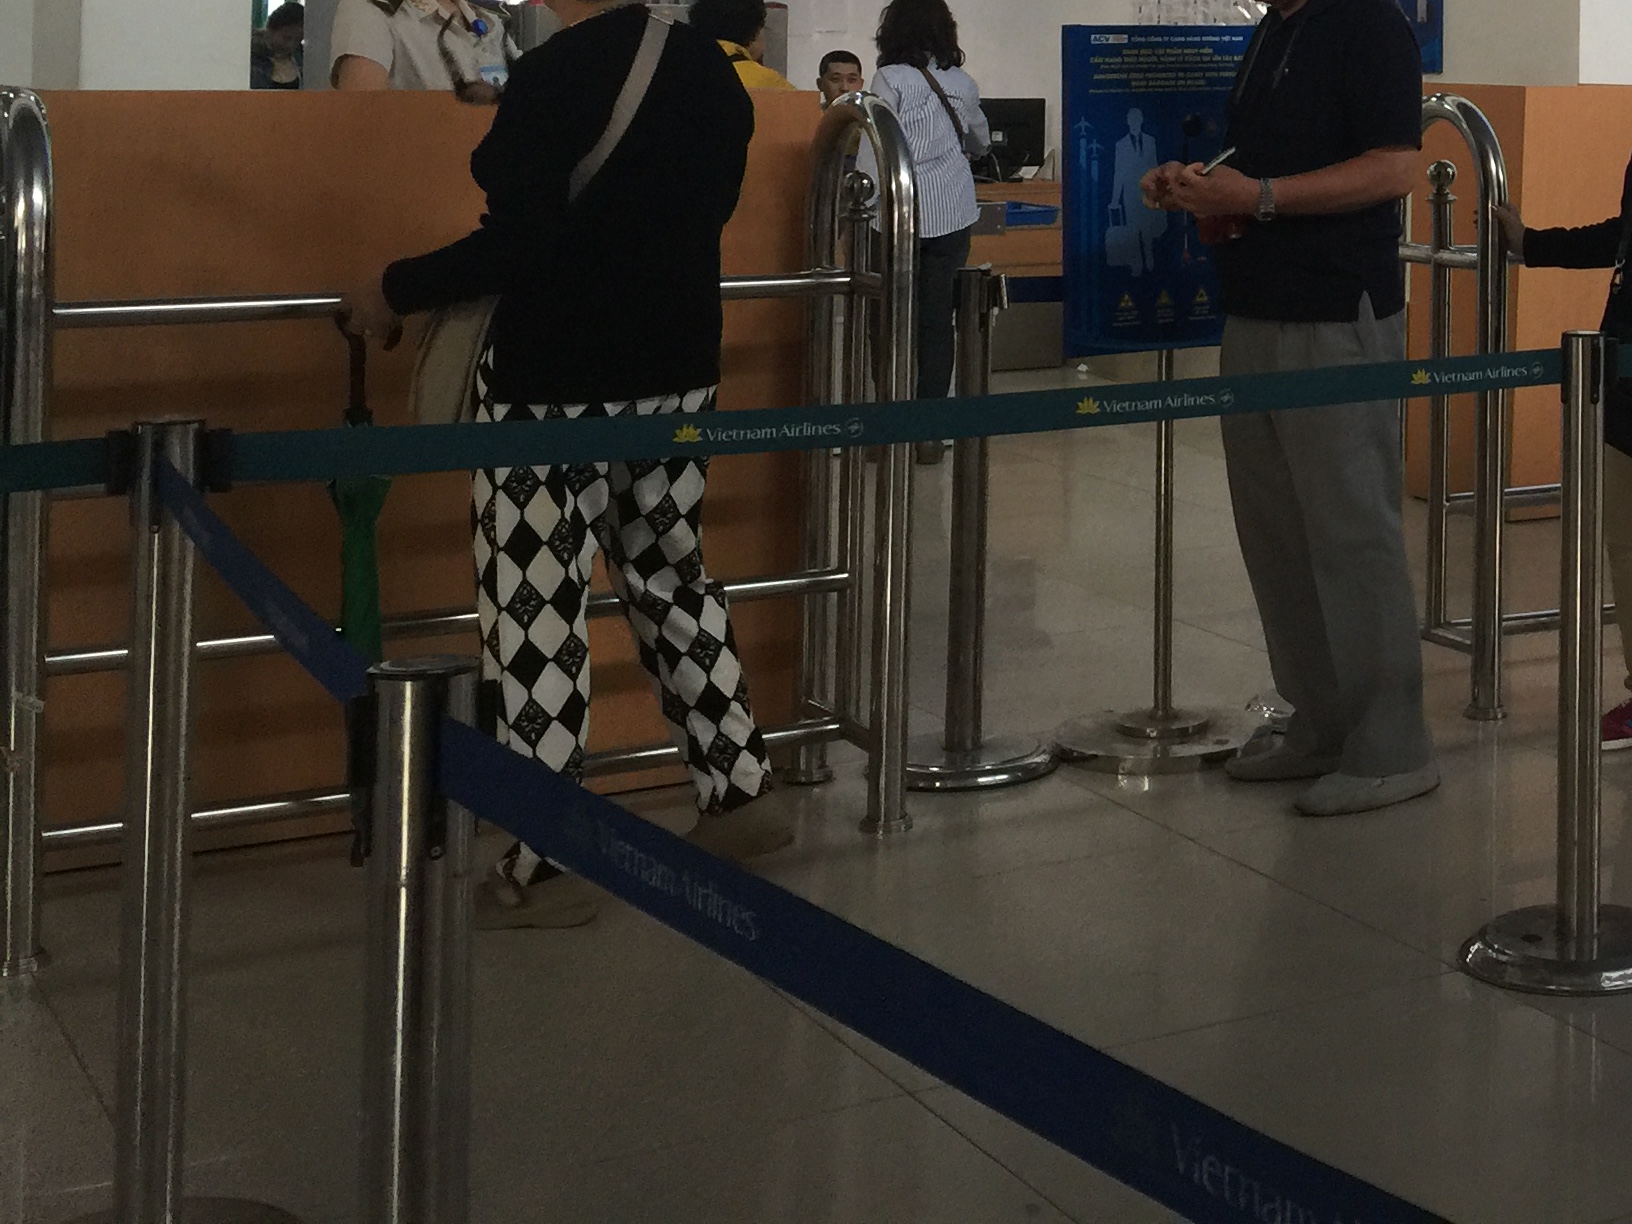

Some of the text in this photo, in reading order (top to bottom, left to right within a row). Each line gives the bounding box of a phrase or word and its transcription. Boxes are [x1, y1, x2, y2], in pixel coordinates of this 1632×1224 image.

[1092, 35, 1111, 43] ACV
[1433, 365, 1528, 384] Vietnam Airlines
[1102, 393, 1215, 413] Vietnam Airlines
[706, 421, 841, 442] Vietnam Airlines
